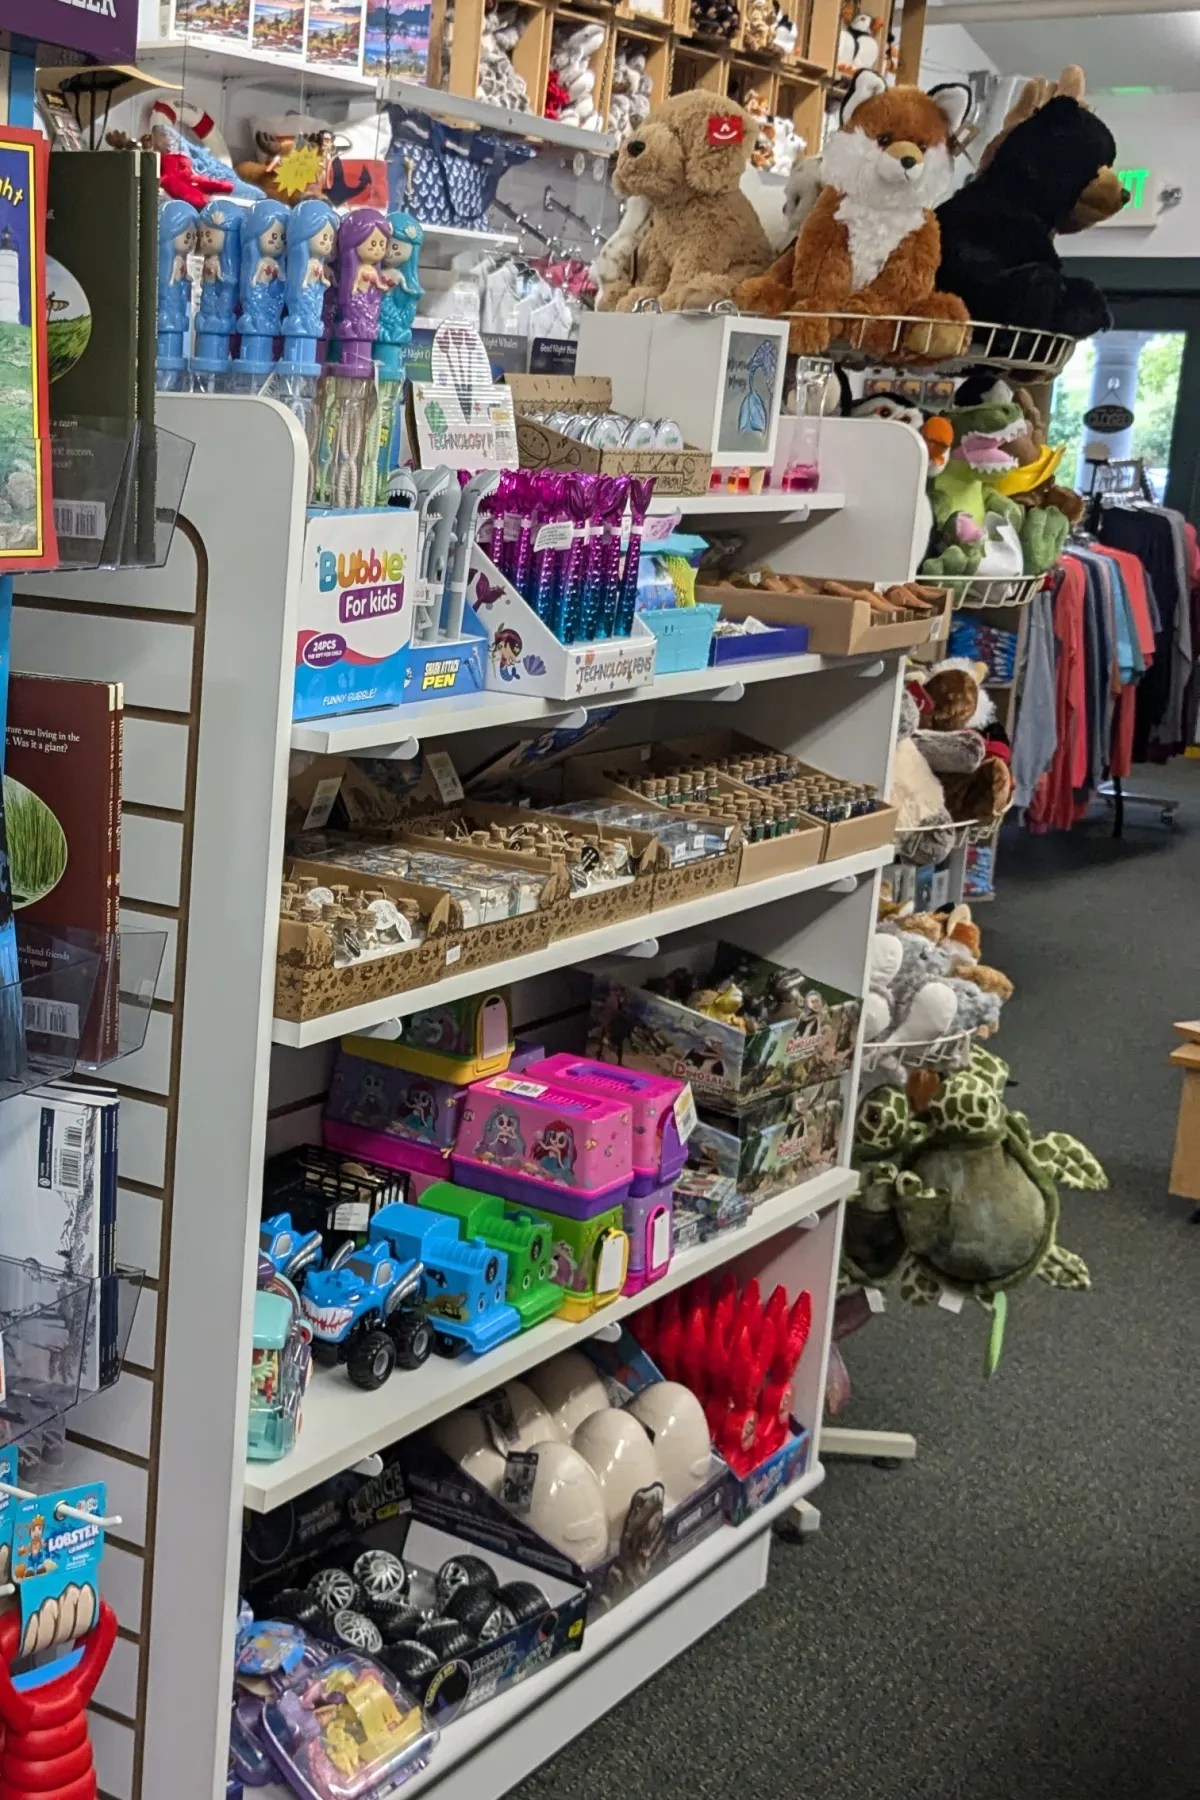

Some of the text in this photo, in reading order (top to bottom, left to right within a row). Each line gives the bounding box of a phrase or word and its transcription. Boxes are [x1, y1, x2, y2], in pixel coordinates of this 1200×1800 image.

[427, 432, 486, 450] TECHNOLOGY
[318, 547, 404, 592] Bubble
[344, 590, 398, 618] For kids
[312, 639, 337, 653] 24PCS
[576, 658, 652, 683] TECHNOLOGY PENS
[421, 672, 456, 690] PEN
[322, 691, 346, 706] FUNNY
[23, 727, 80, 742] was living in the
[12, 736, 29, 747] Was
[31, 740, 37, 749] it
[44, 741, 68, 754] giant?
[45, 948, 70, 961] friends
[48, 1523, 100, 1553] LOBSTER
